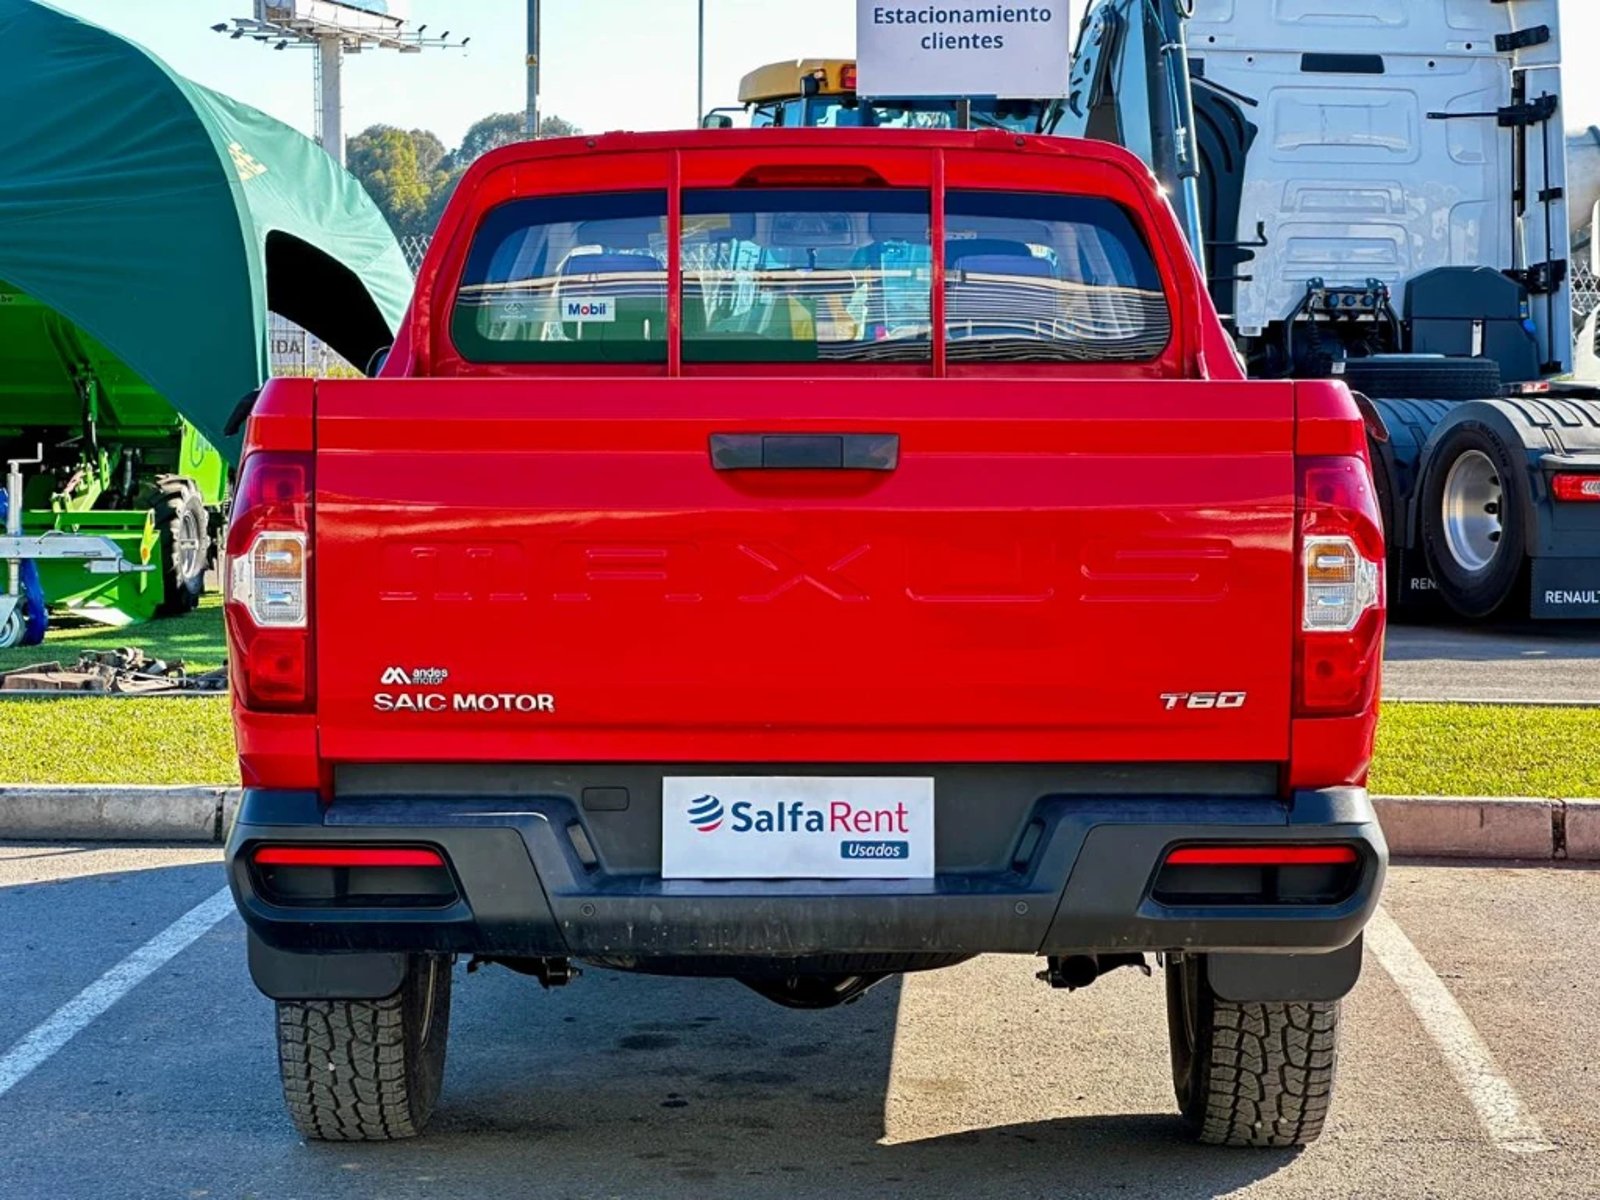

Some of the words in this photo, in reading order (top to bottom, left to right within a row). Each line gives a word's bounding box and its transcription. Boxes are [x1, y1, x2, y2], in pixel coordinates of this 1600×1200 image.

[873, 5, 1051, 24] Estacionamiento
[920, 32, 1004, 49] clientes
[567, 302, 607, 316] Mobil
[412, 667, 448, 678] andes
[373, 693, 447, 712] SAIC
[453, 693, 555, 713] MOTOR
[1160, 691, 1247, 710] T60
[730, 800, 909, 833] SalfaRent
[848, 843, 901, 857] Usados
